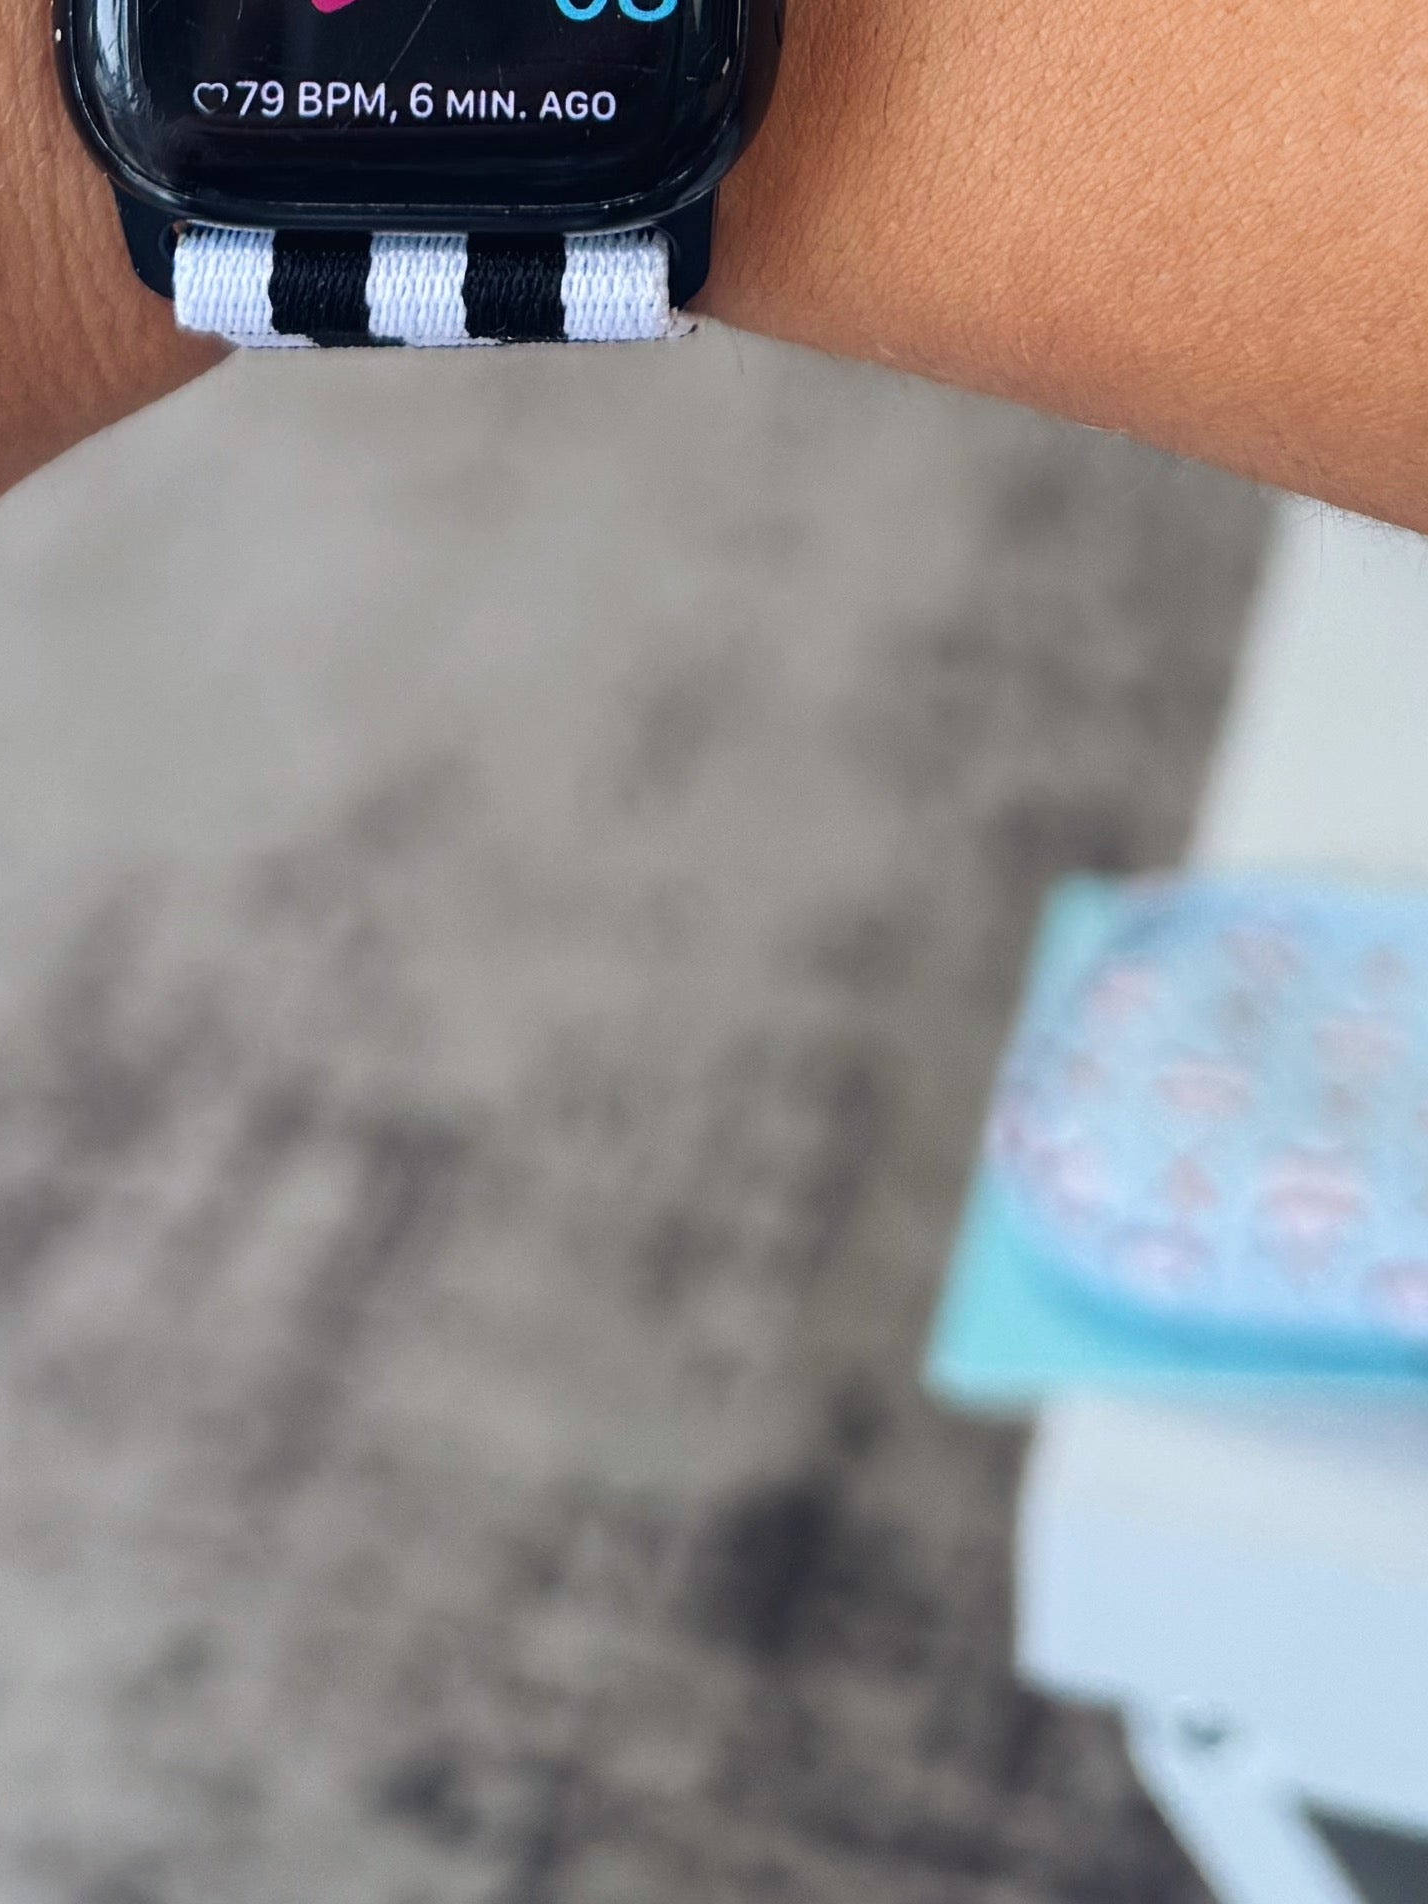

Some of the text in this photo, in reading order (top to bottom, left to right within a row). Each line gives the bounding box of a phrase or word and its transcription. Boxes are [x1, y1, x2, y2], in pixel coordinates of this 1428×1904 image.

[235, 80, 616, 124] 79 BPM, 6 MIN. AGO
